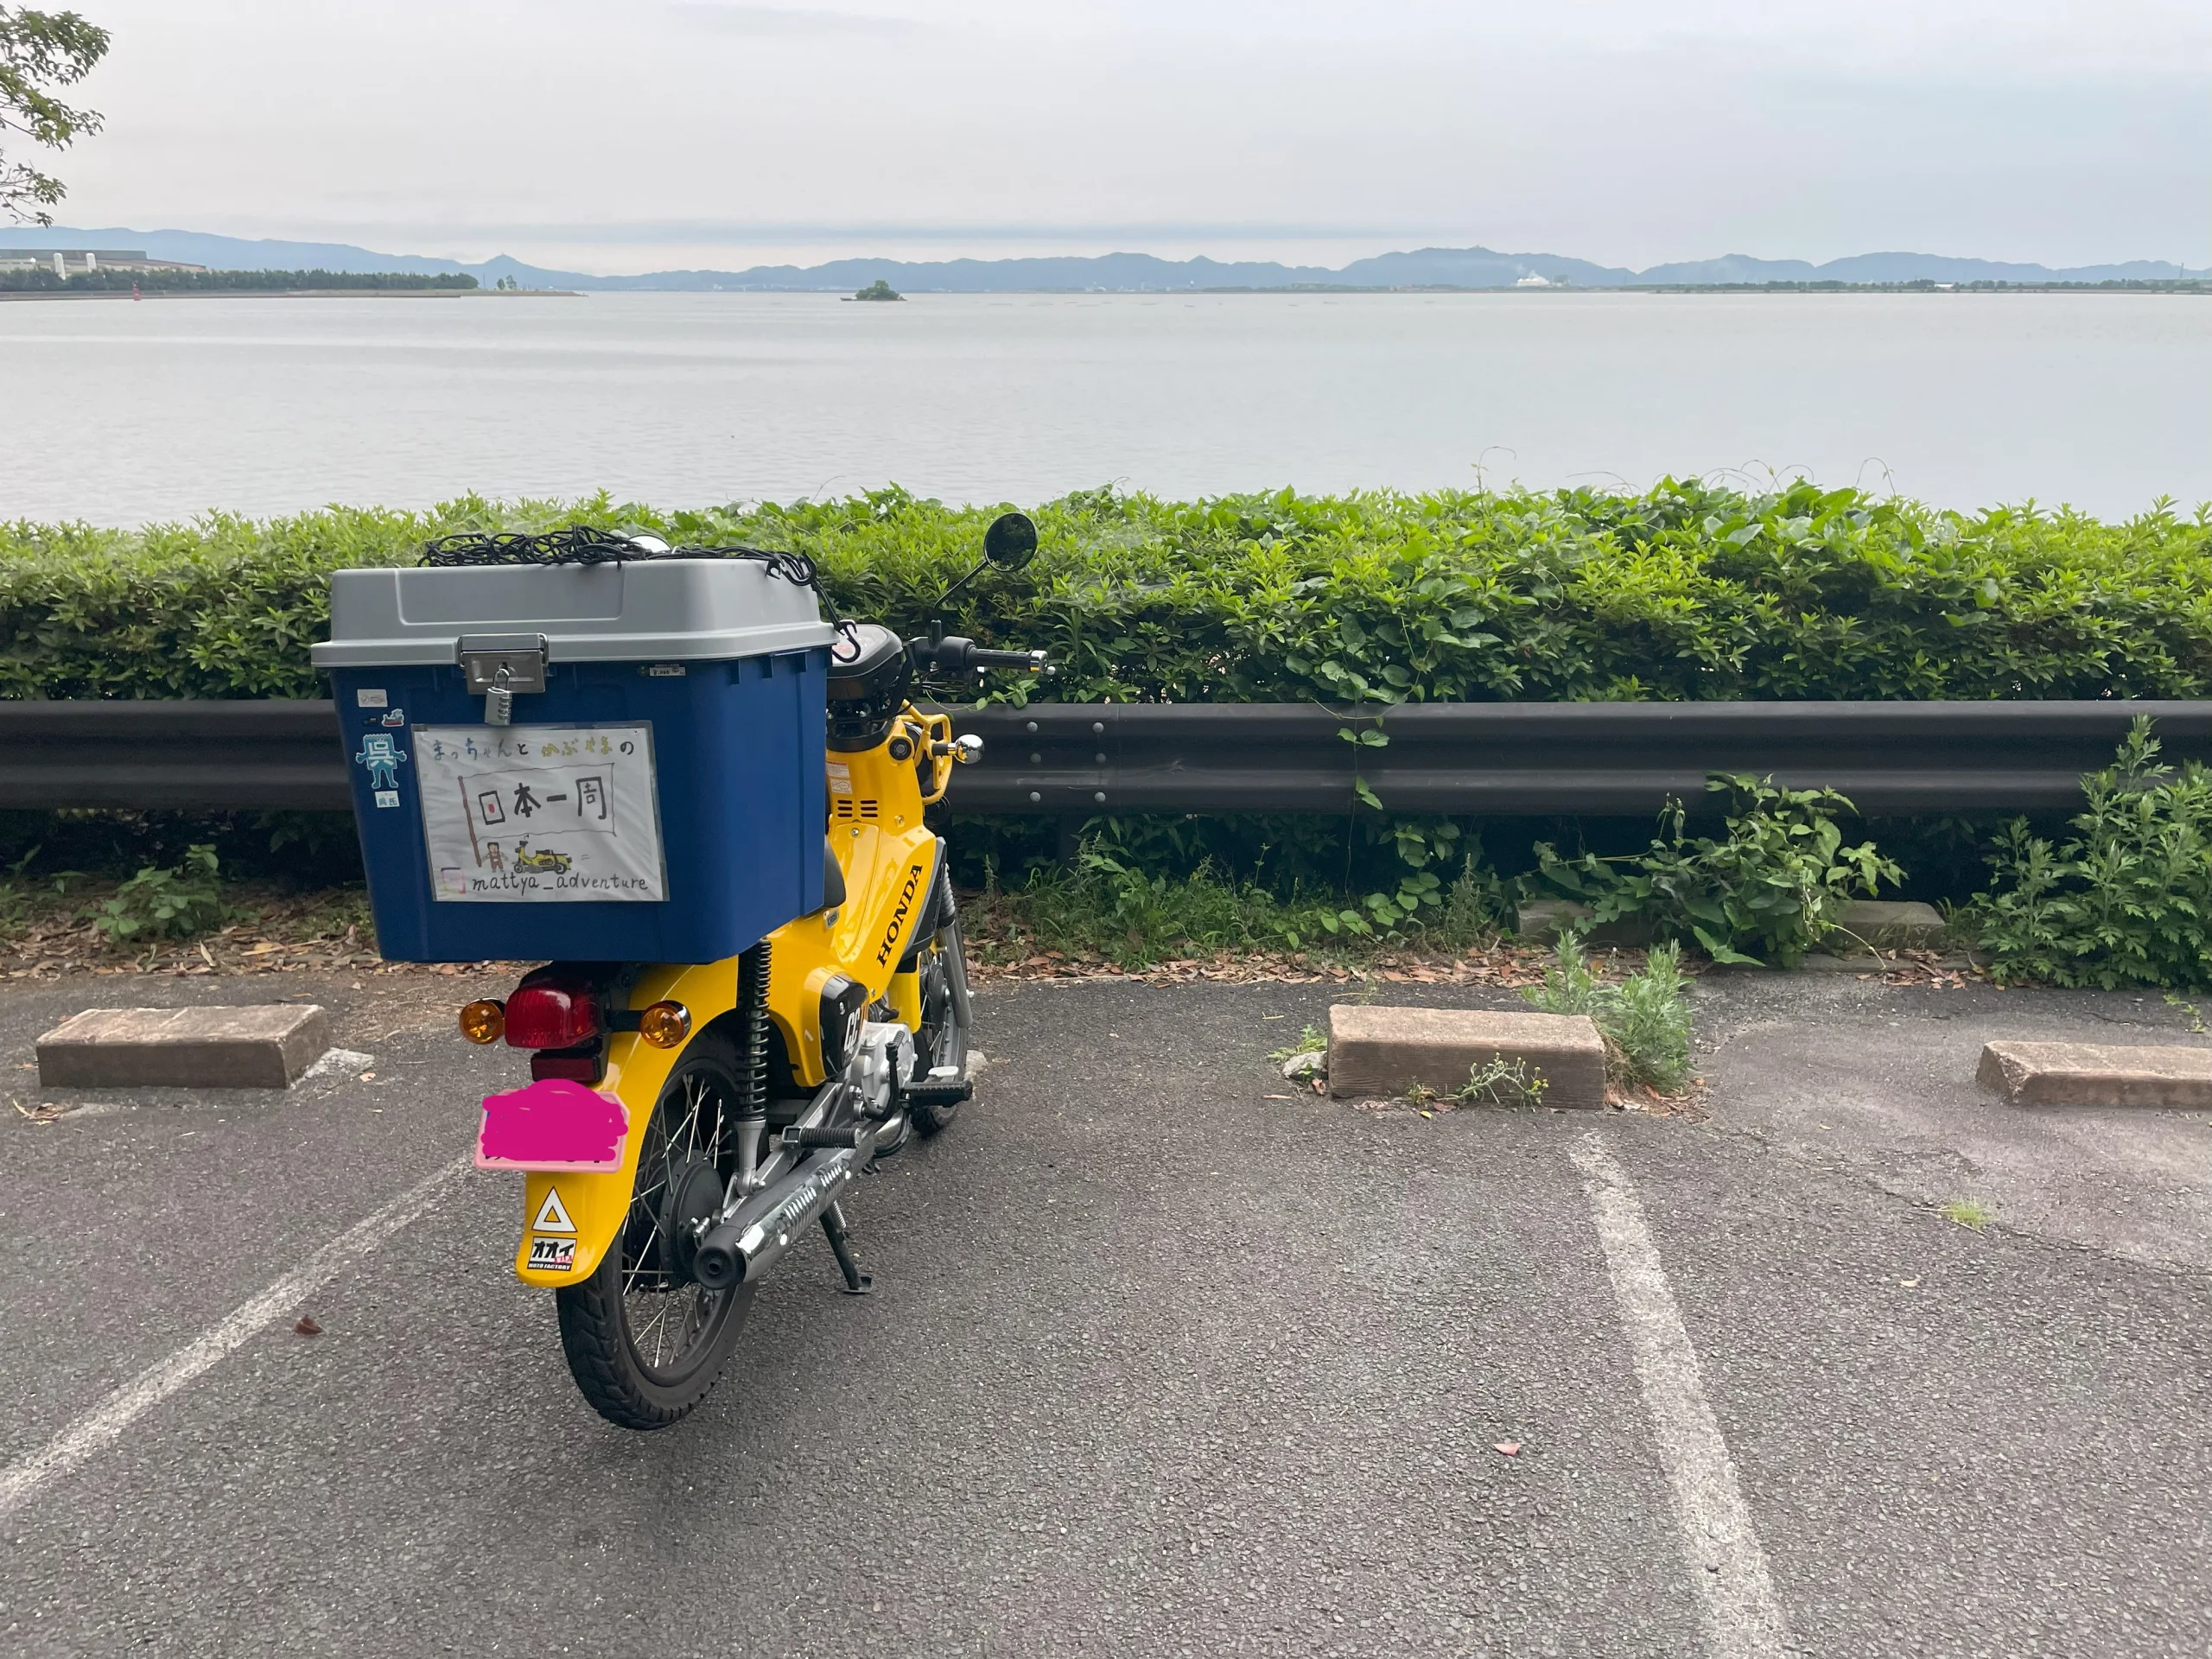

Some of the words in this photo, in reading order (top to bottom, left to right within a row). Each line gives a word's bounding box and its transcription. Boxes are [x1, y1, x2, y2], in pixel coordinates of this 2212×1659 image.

[479, 776, 607, 825] 日本一周
[876, 864, 923, 969] HONDA
[531, 1241, 575, 1259] オオイ
